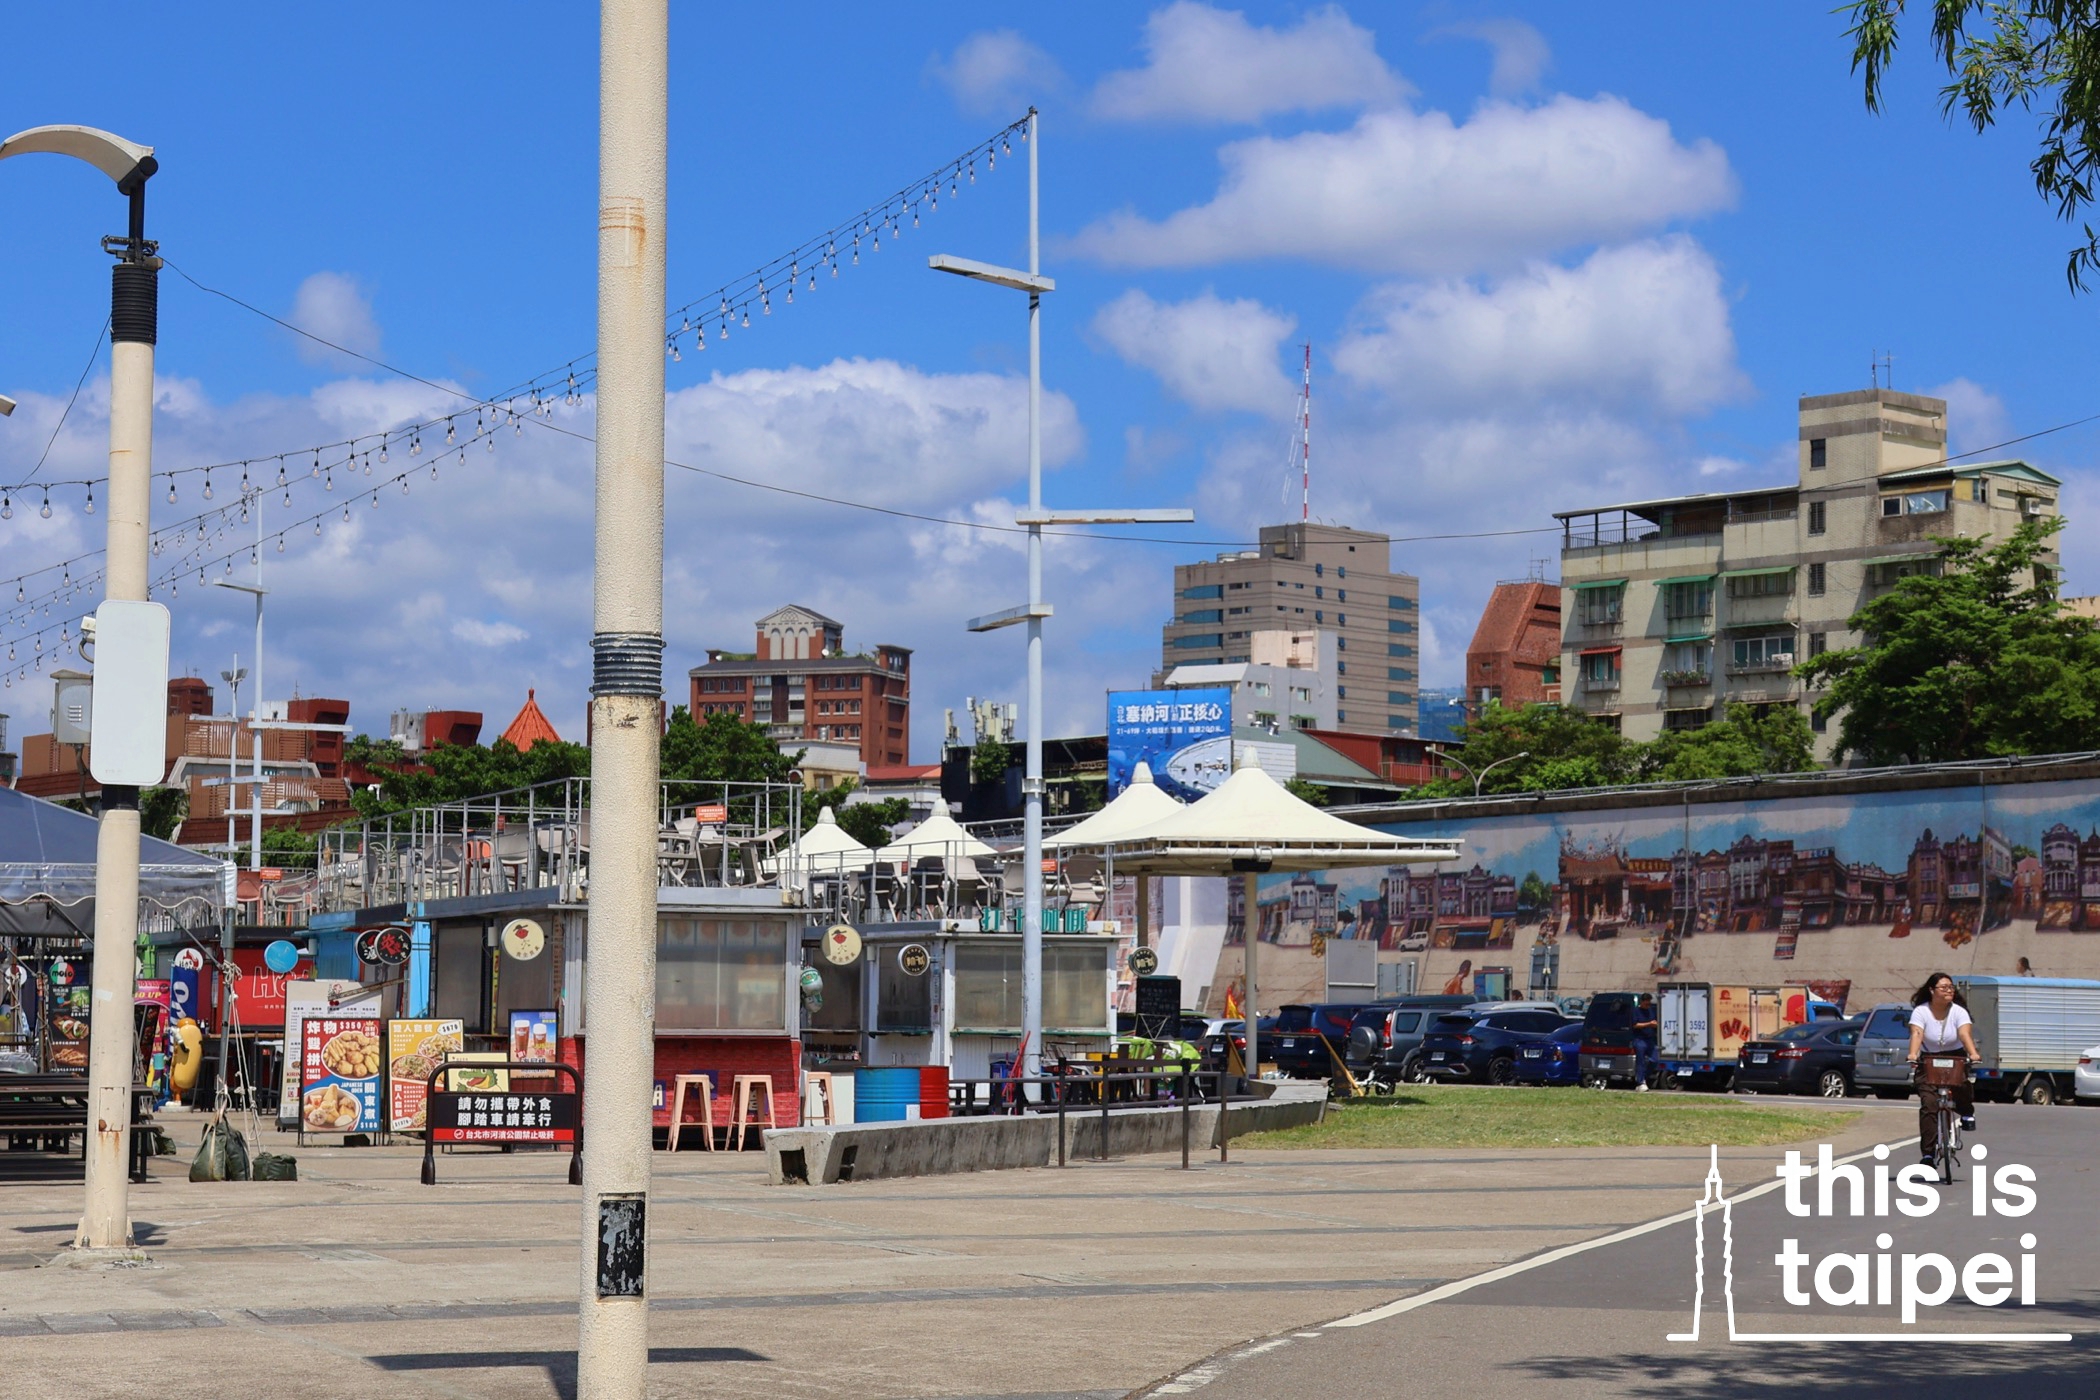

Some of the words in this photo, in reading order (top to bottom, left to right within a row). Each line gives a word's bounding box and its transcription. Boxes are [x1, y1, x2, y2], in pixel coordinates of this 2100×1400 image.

[1126, 704, 1169, 723] 塞納河
[1180, 702, 1222, 721] 正核心
[306, 1020, 337, 1035] 炸物
[340, 1021, 361, 1030] $350
[364, 1082, 375, 1119] 關東煮
[457, 1096, 552, 1111] 請勿攜帶外食
[457, 1112, 552, 1127] 腳踏車請牽行
